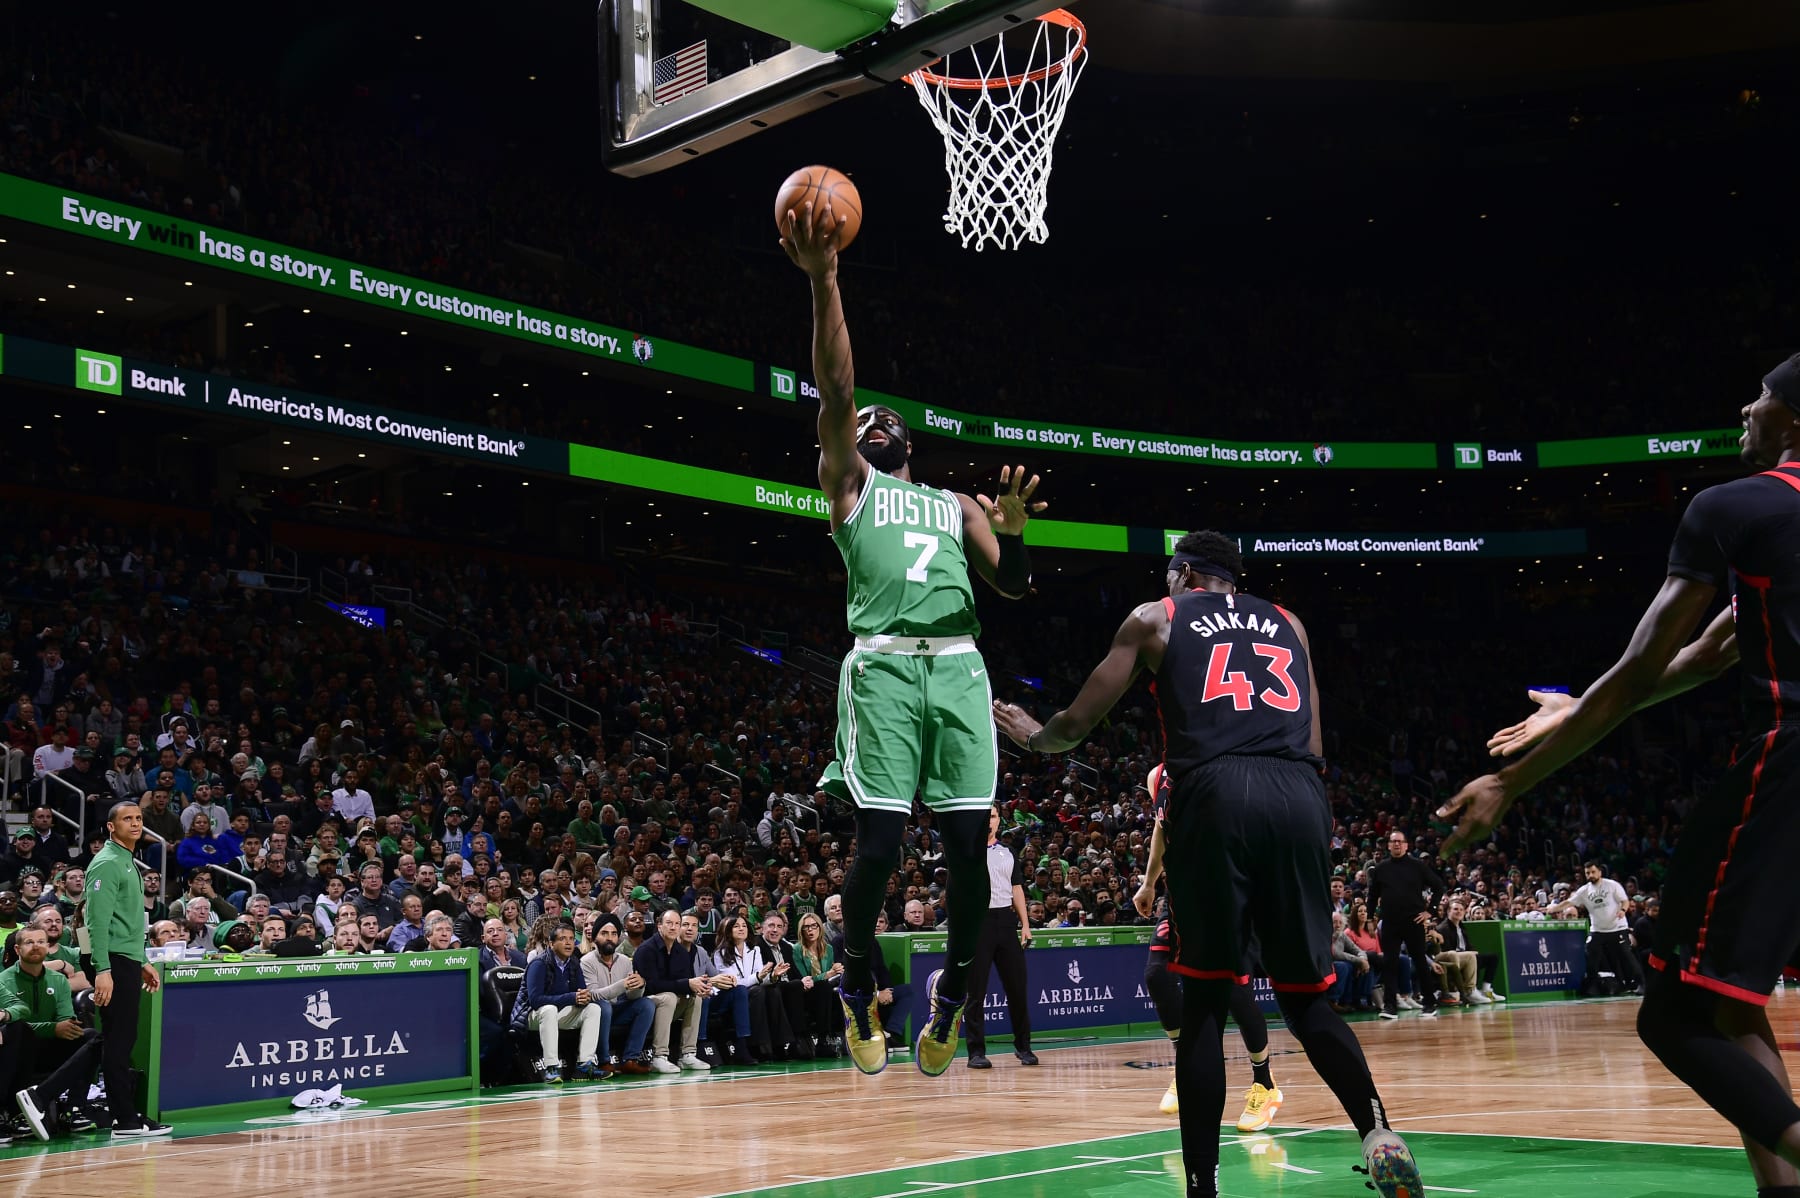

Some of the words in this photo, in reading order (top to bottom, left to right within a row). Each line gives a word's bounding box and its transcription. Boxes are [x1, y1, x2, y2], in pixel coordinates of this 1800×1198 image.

[62, 196, 142, 241] Every
[147, 223, 194, 250] win
[199, 230, 245, 262] has
[249, 249, 266, 268] a
[269, 254, 336, 287] story.
[349, 268, 412, 306] Every
[415, 290, 514, 327] customer
[516, 309, 552, 337] has
[554, 324, 568, 341] a
[570, 327, 622, 354] story.
[80, 356, 118, 387] TD
[130, 369, 187, 397] Bank
[772, 371, 794, 394] TD
[800, 382, 820, 400] Ba
[227, 388, 324, 422] America's
[327, 406, 373, 431] Most
[375, 415, 475, 449] Convenient
[925, 408, 962, 435] Every
[964, 420, 991, 437] win
[994, 422, 1024, 441] has
[1026, 428, 1037, 442] a
[1039, 429, 1084, 448] story.
[1092, 432, 1136, 453] Every
[1138, 439, 1209, 459] customer
[1211, 444, 1238, 461] has
[1240, 450, 1251, 462] a
[1254, 448, 1303, 464] story.
[1647, 438, 1702, 454] Every
[1456, 447, 1480, 464] TD
[1487, 449, 1522, 463] Bank
[755, 485, 794, 509] Bank
[796, 495, 813, 512] of
[874, 487, 961, 540] BOSTON
[1253, 538, 1321, 553] America's
[1324, 538, 1360, 552] Most
[1361, 538, 1441, 552] Convenient
[903, 531, 939, 583] 7
[1189, 612, 1280, 639] SIAKAM
[1200, 642, 1301, 712] 43
[255, 964, 283, 975] xfinity
[296, 963, 322, 974] xfinity
[335, 961, 360, 973] xfinity
[372, 959, 397, 970] xfinity
[409, 957, 433, 968] xfinity
[444, 955, 468, 966] xfinity
[1520, 960, 1572, 976] ARBELLA
[171, 967, 199, 979] xfinity
[213, 966, 242, 977] xfinity
[1527, 977, 1566, 987] INSURANCE
[1037, 985, 1114, 1004] ARBELLA
[1049, 1004, 1105, 1016] INSURANCE
[224, 1030, 409, 1069] ARBELLA
[250, 1064, 386, 1089] INSURANCE
